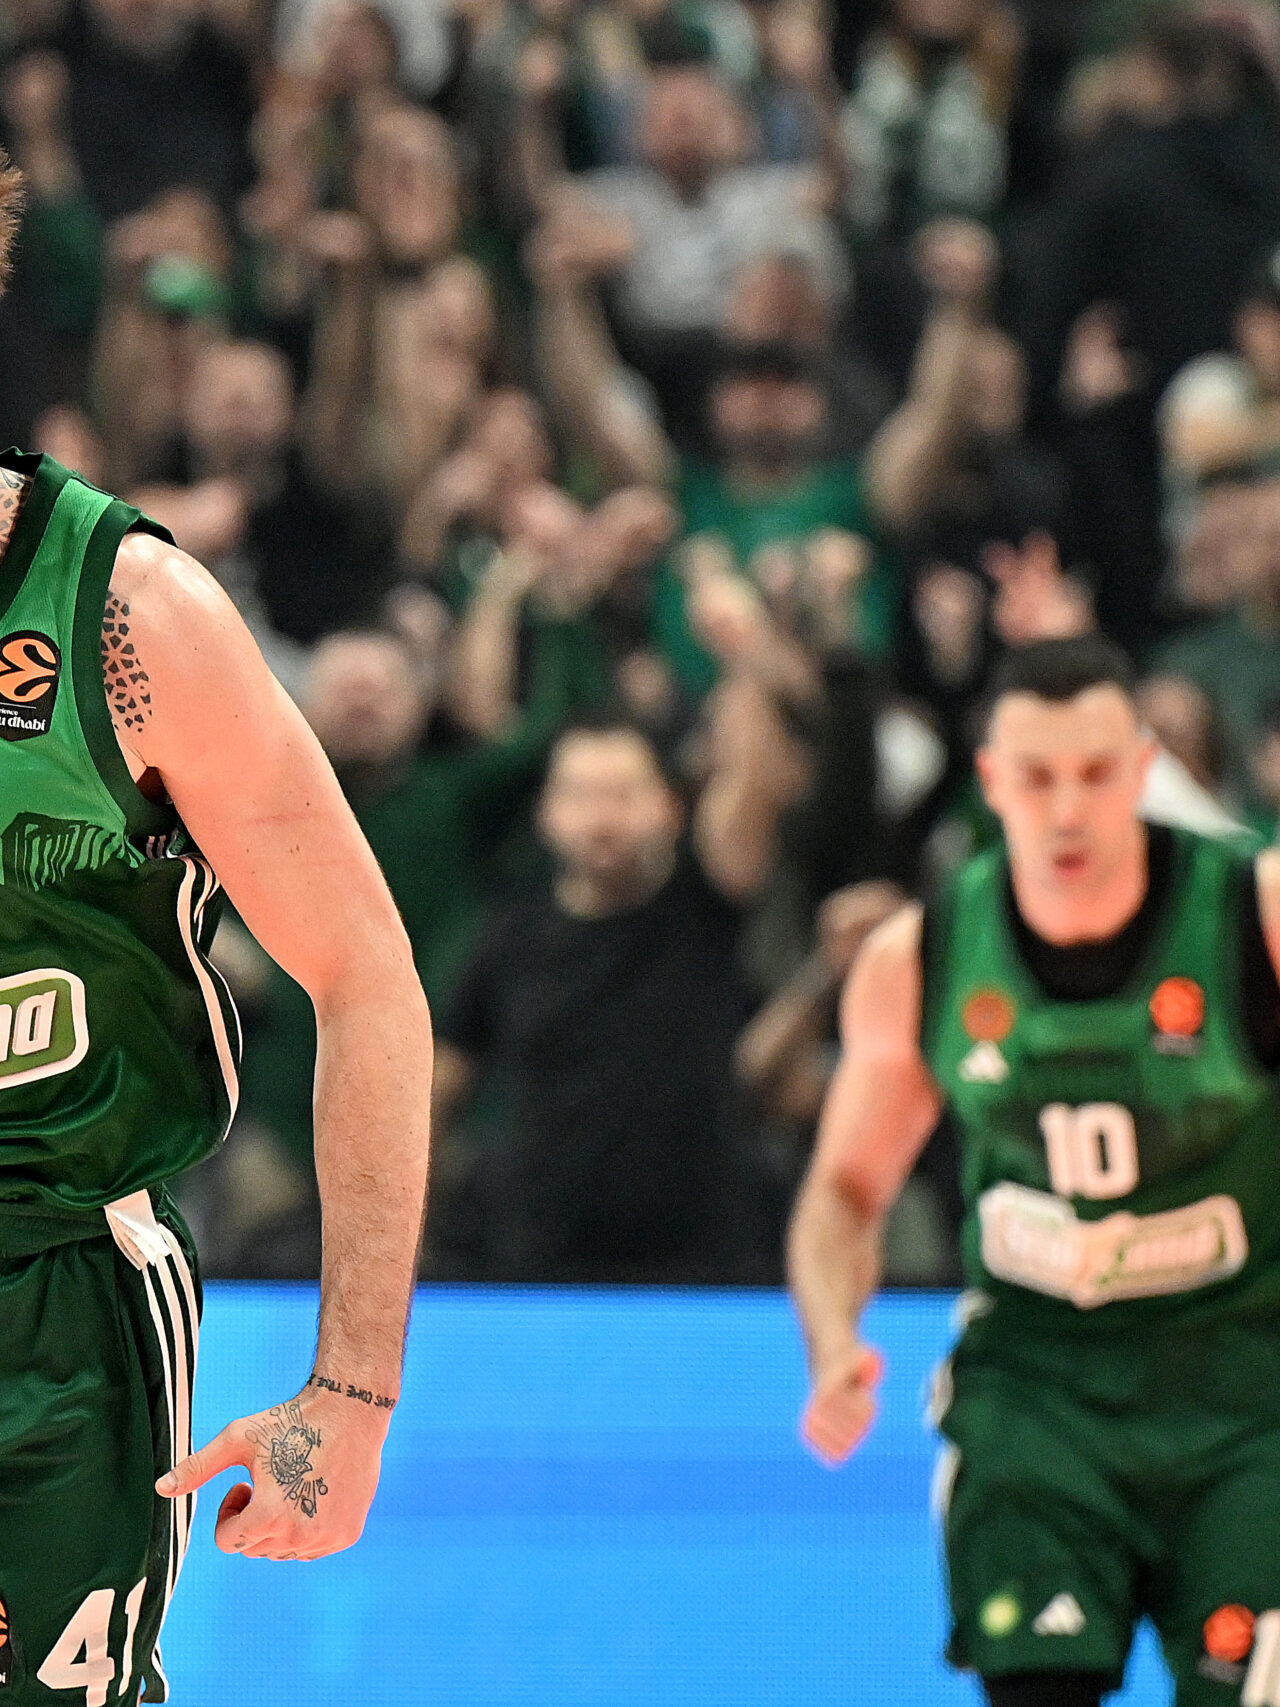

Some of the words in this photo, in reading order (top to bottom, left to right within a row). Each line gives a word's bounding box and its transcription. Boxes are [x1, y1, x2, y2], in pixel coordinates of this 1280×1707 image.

[7, 716, 47, 731] dhabi
[1039, 1101, 1140, 1200] 10
[36, 1576, 147, 1707] 41
